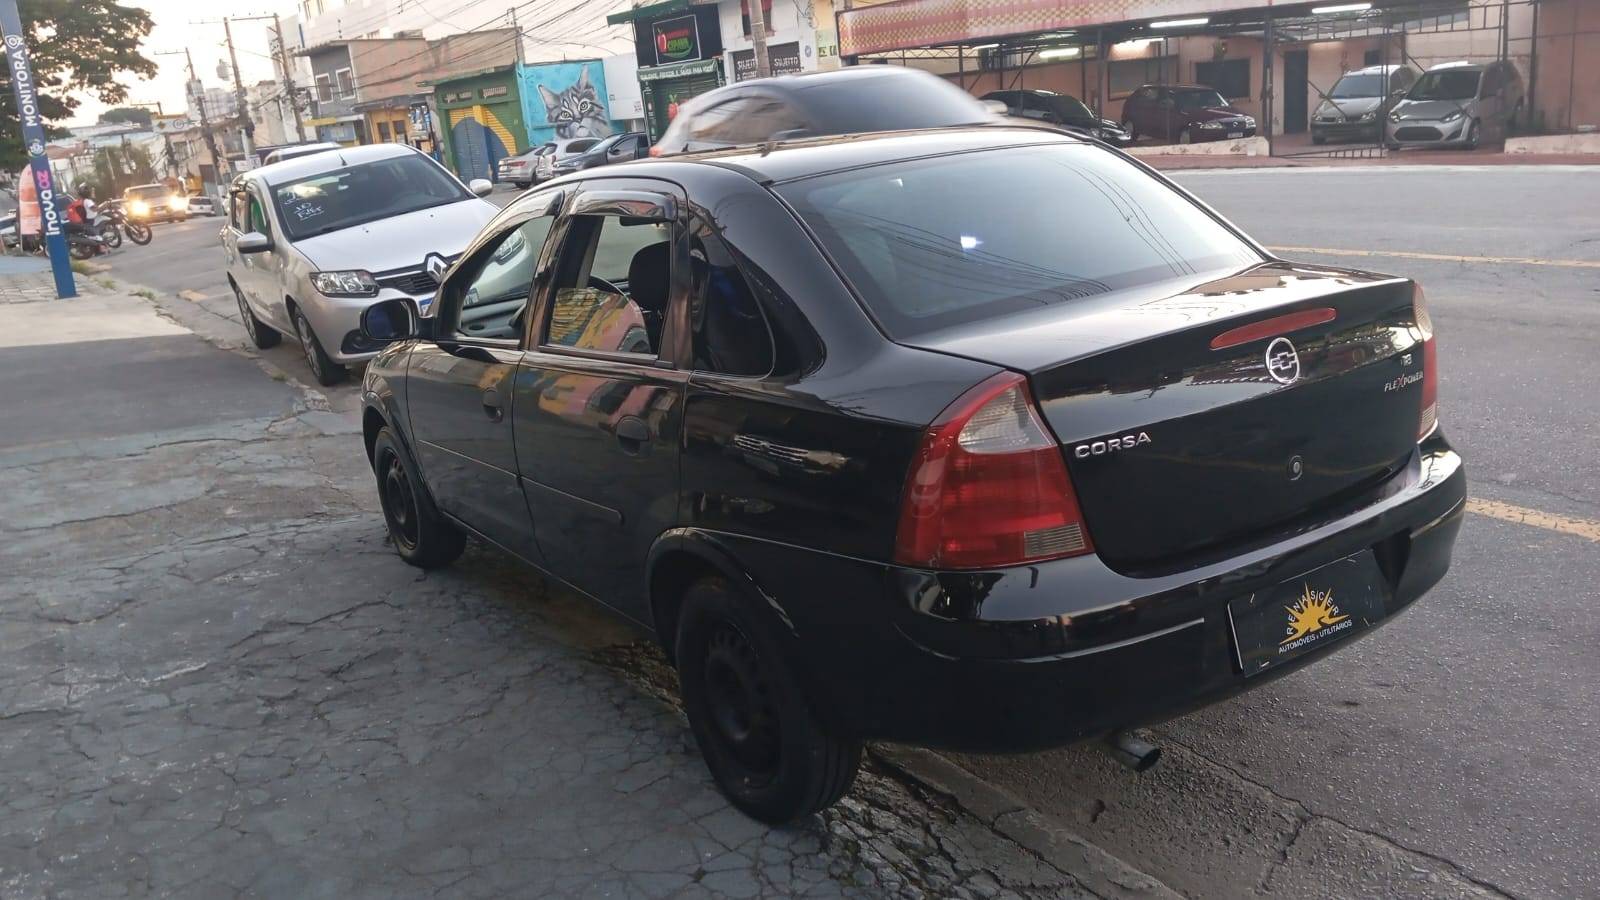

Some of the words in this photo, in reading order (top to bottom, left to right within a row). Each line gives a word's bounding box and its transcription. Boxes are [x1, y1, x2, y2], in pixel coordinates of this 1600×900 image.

[12, 50, 38, 127] MONITORA
[1075, 432, 1152, 458] CORSA
[1286, 590, 1339, 635] RENASCER
